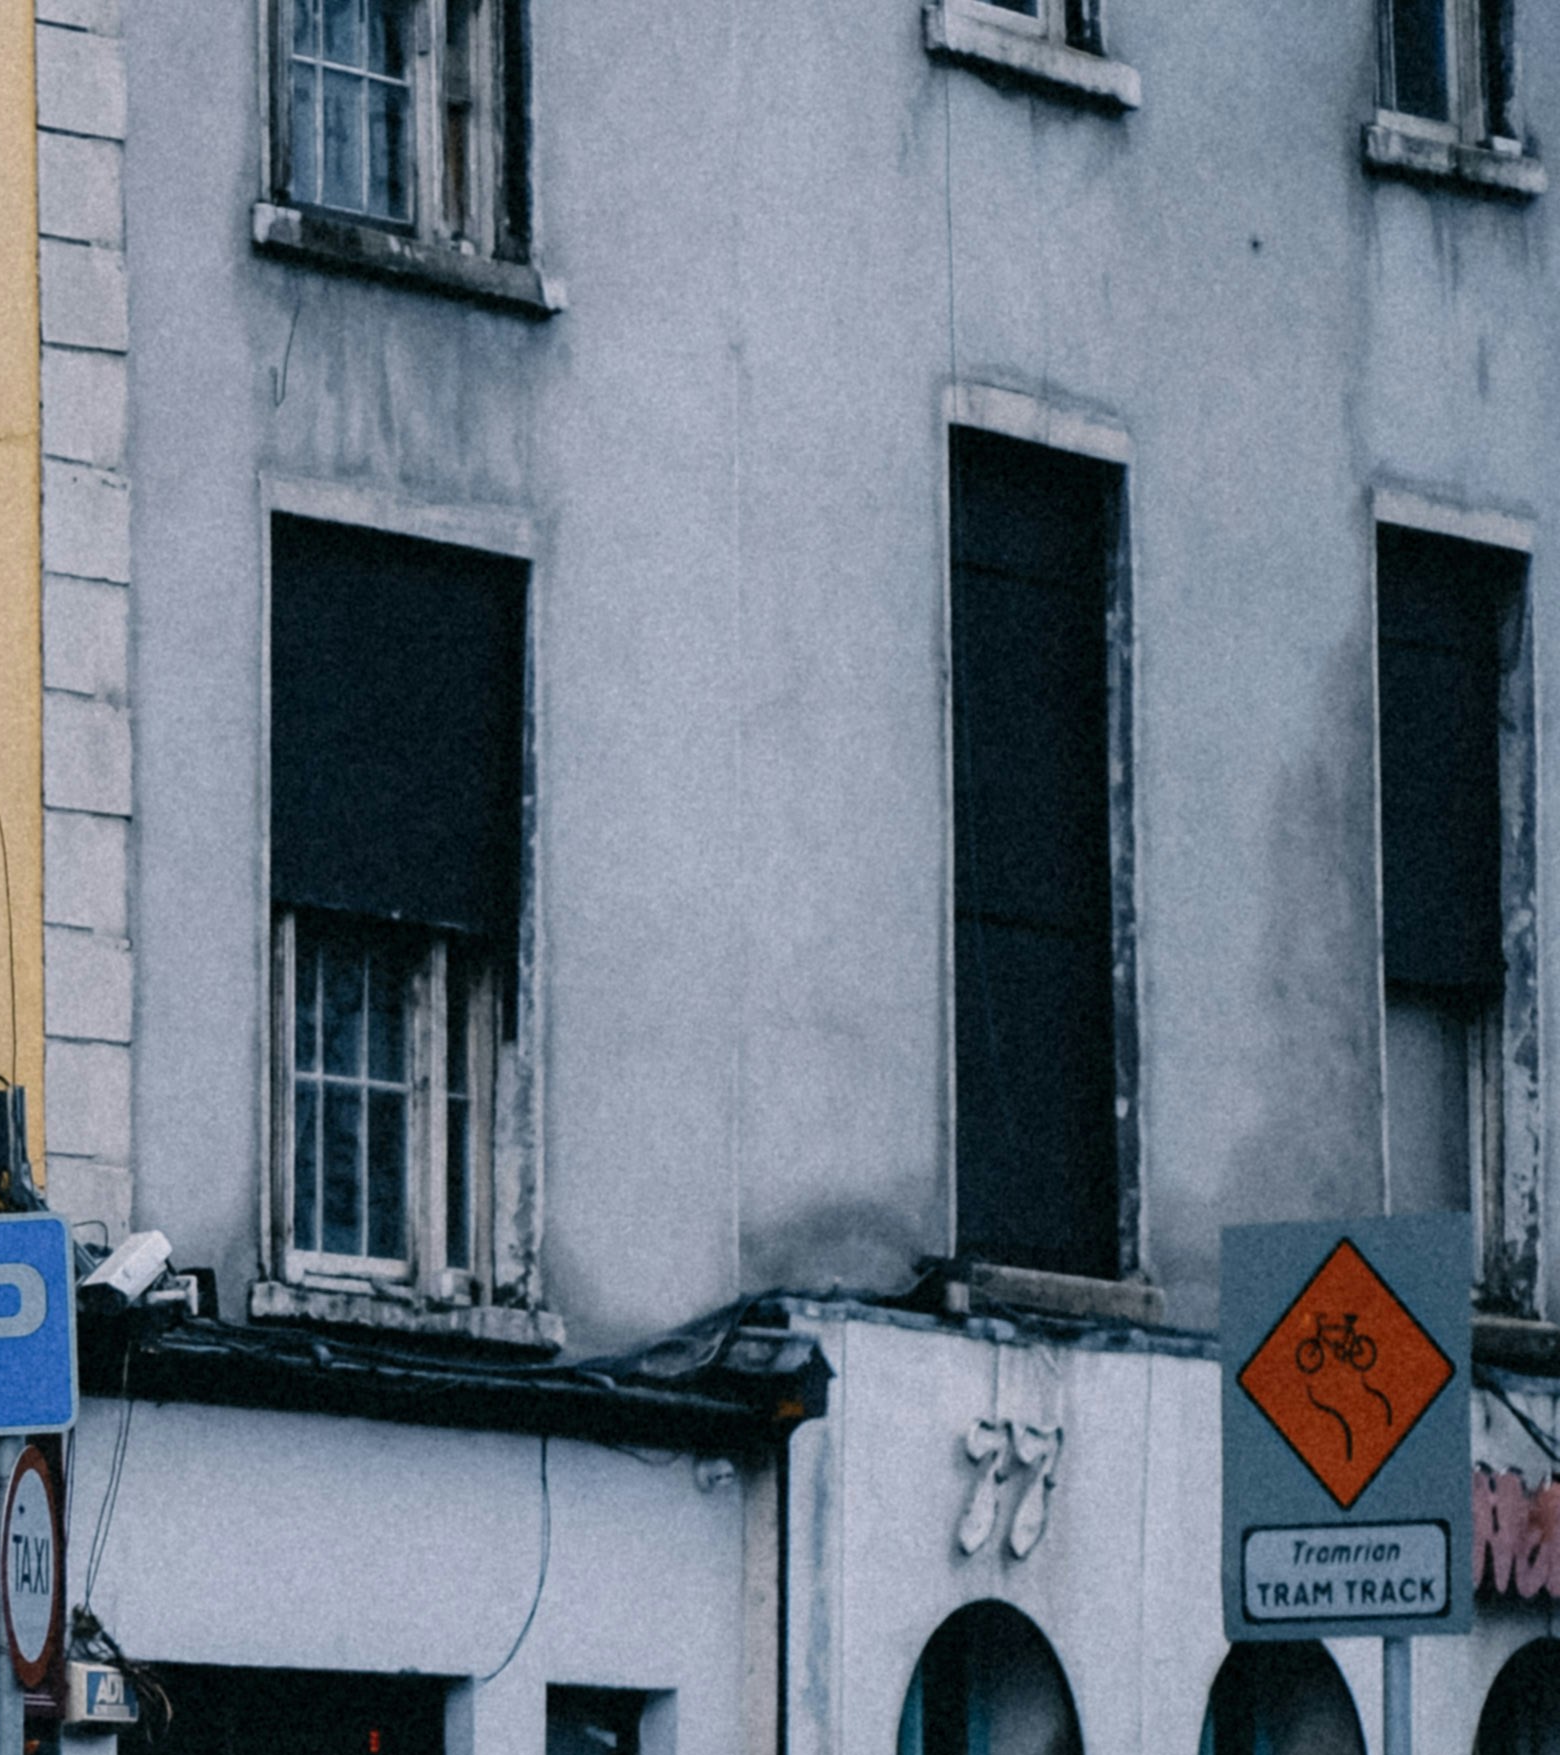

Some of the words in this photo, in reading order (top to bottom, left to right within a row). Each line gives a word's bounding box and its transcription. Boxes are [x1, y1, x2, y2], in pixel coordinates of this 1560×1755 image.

[12, 1533, 51, 1596] TAXI
[1292, 1539, 1402, 1568] Tramrian
[1257, 1582, 1334, 1608] TRAM
[1345, 1577, 1436, 1604] TRACK
